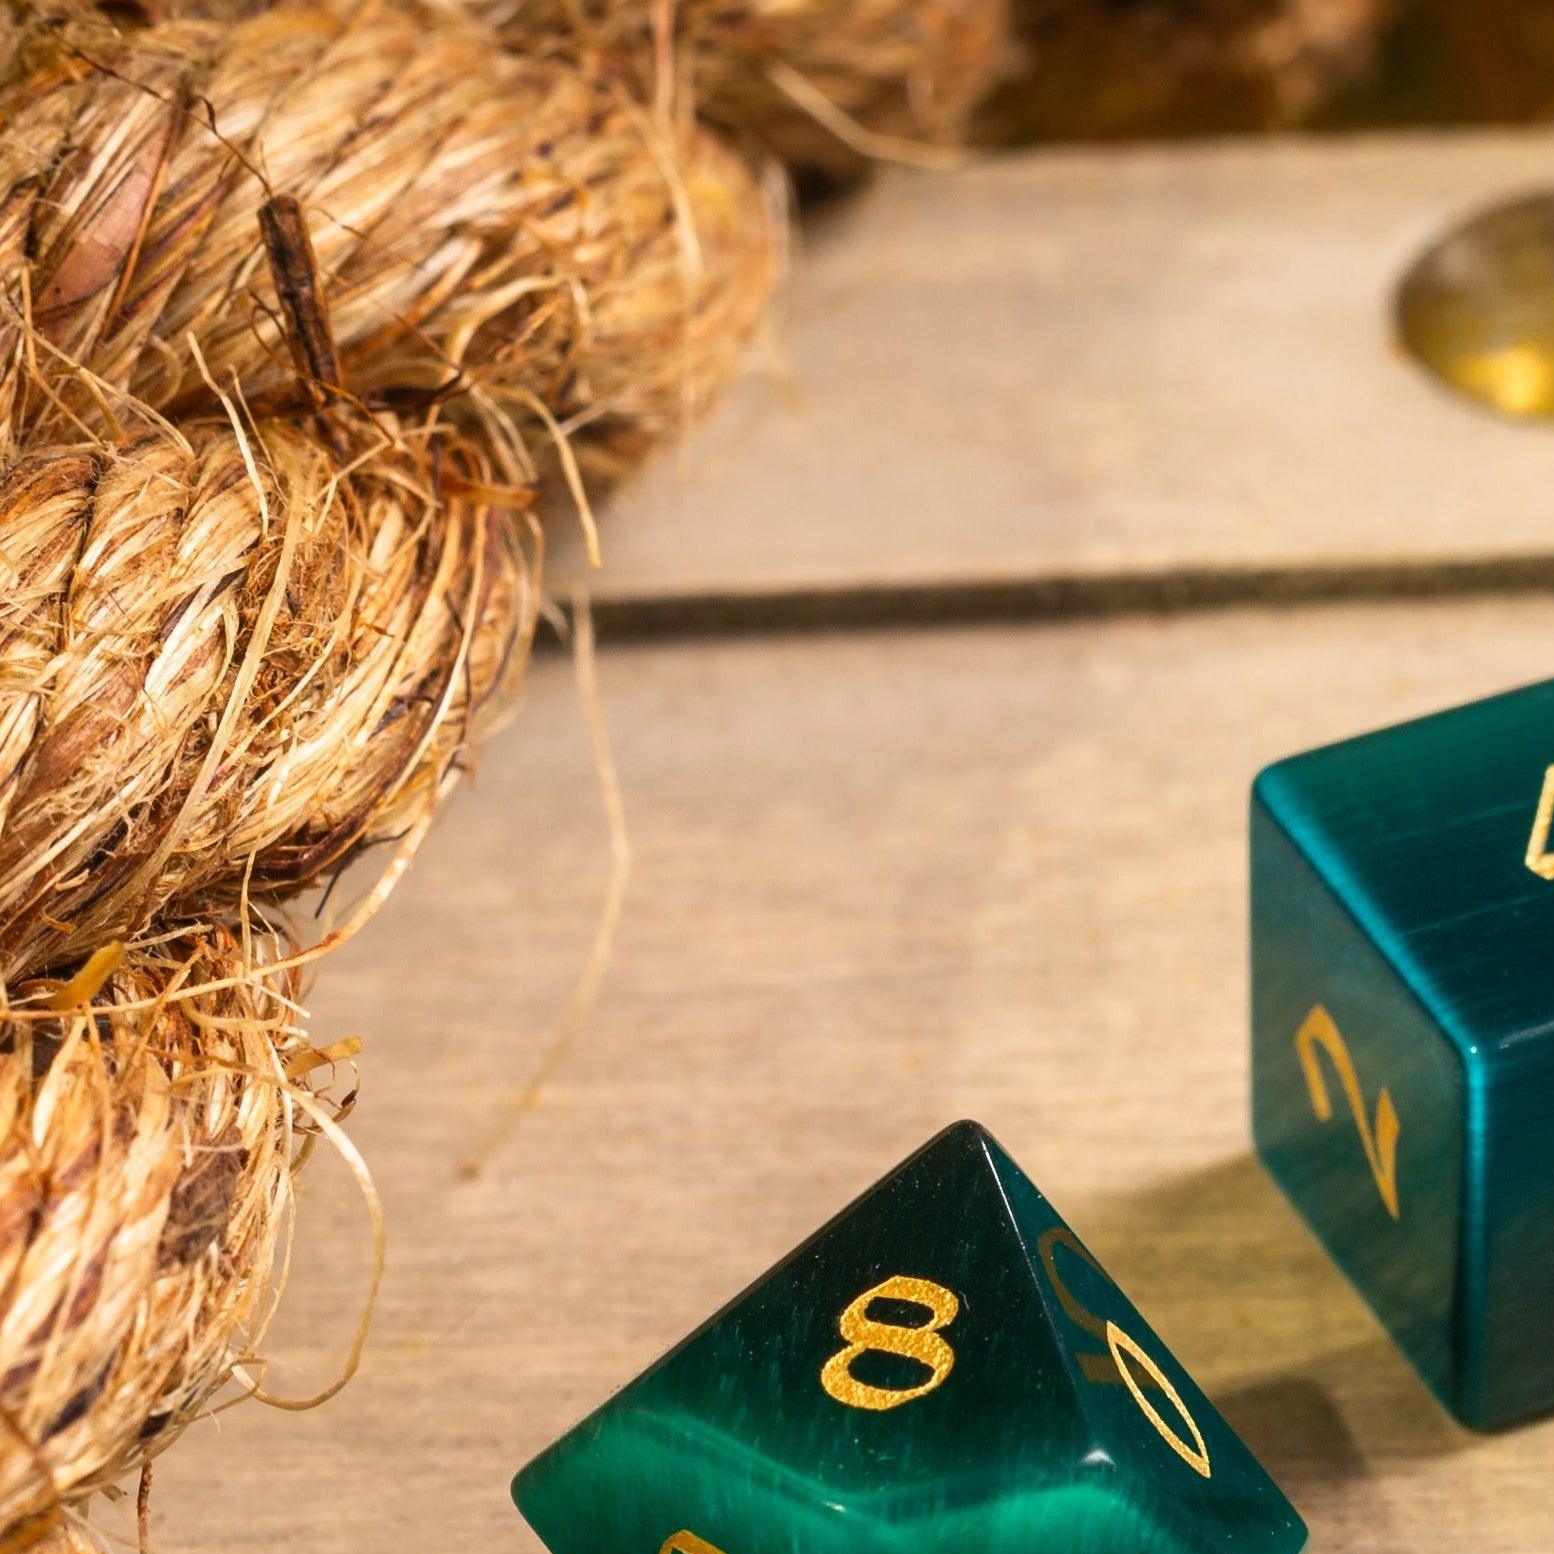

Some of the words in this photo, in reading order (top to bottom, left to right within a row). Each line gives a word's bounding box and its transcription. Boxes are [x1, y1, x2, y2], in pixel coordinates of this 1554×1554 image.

[1294, 1004, 1401, 1220] 2
[819, 1274, 960, 1412] 8
[1106, 1319, 1212, 1478] 0
